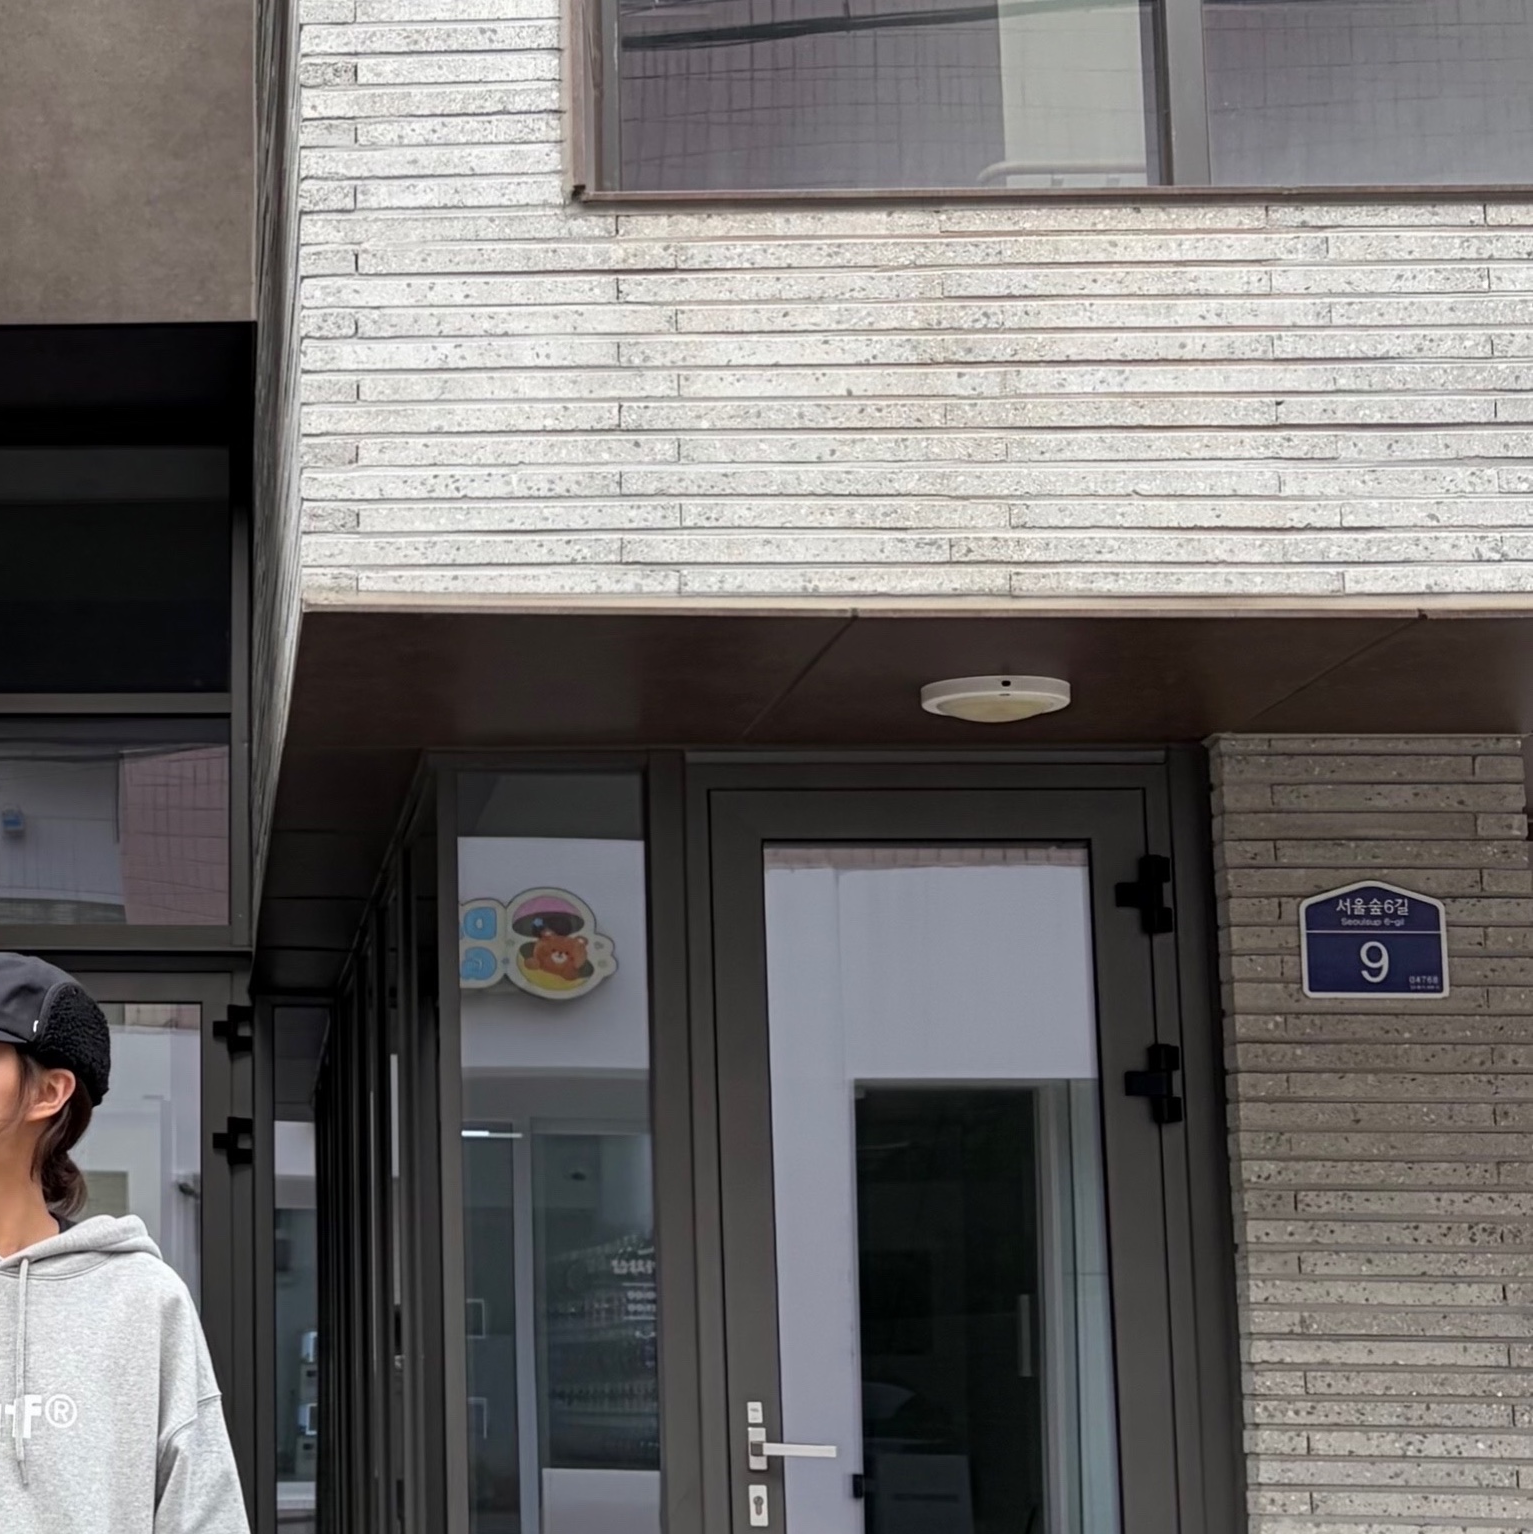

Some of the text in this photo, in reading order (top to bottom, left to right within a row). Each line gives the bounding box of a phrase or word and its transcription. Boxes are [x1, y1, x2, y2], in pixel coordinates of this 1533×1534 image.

[1335, 897, 1409, 916] 서울숲6길
[1340, 917, 1405, 928] Seoulsup 6-gil
[1359, 940, 1390, 984] 9
